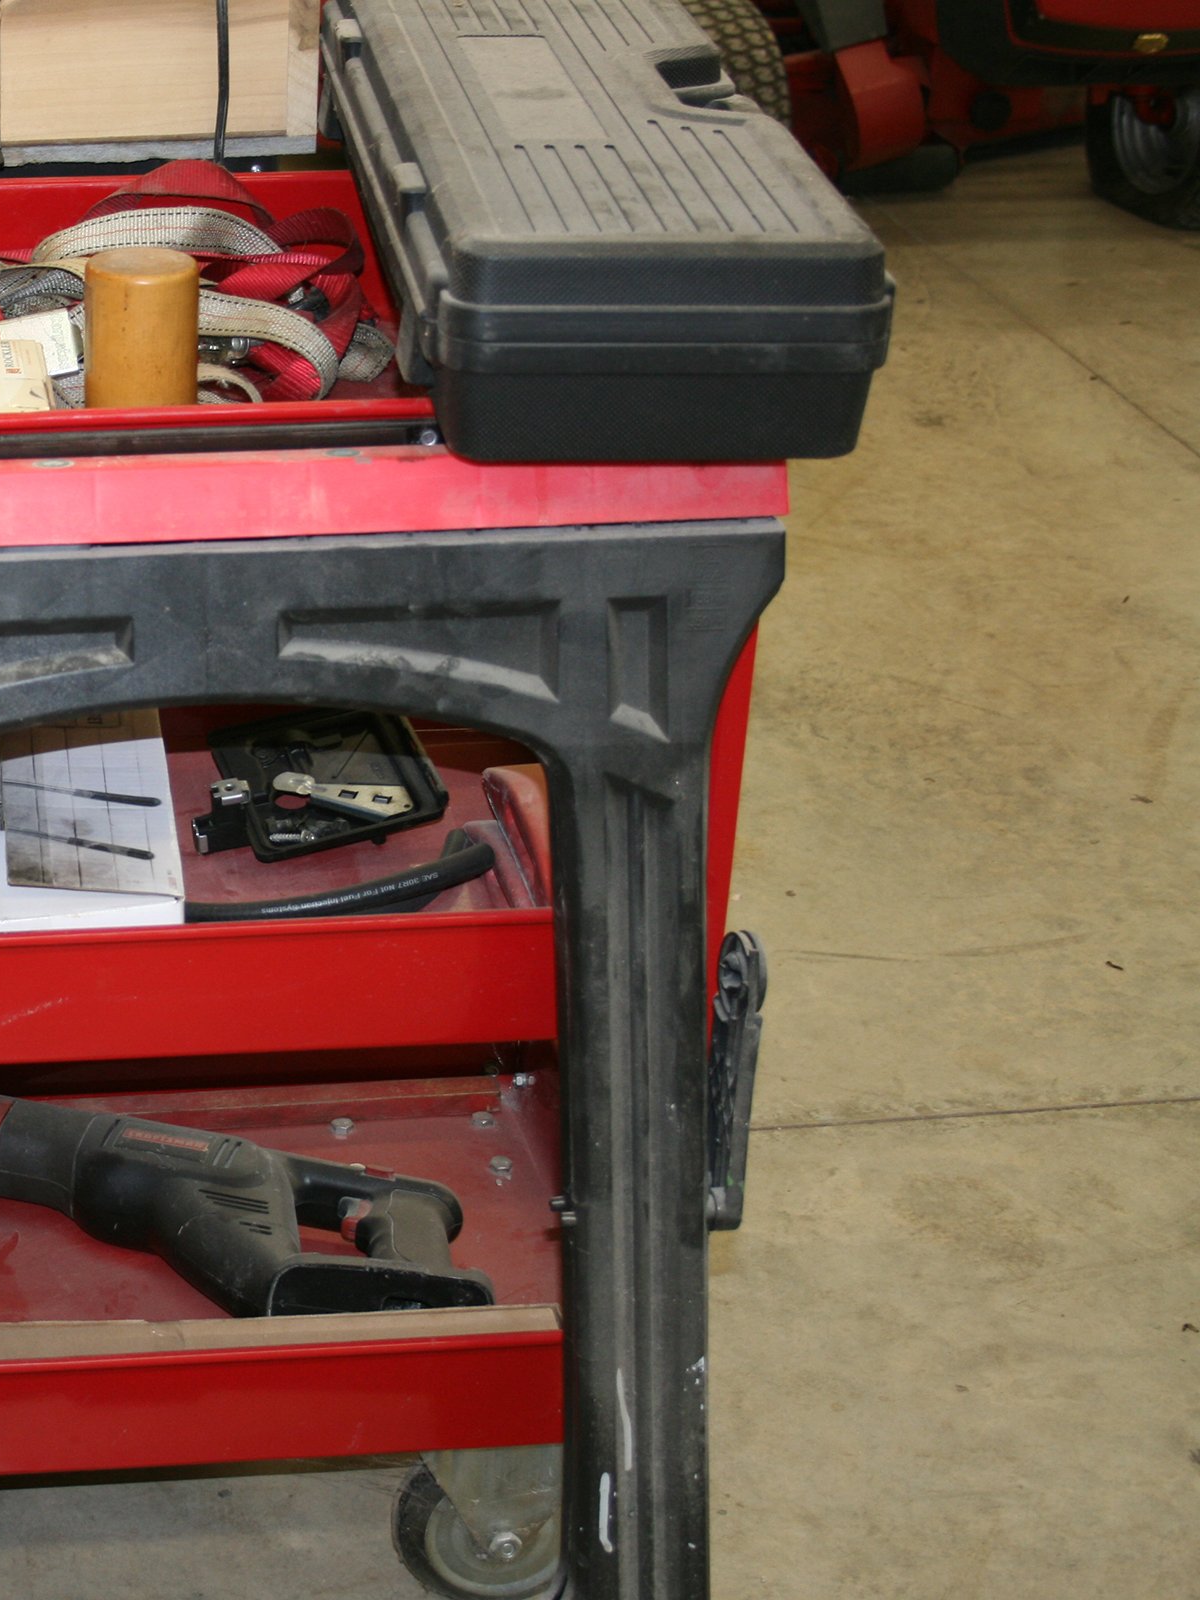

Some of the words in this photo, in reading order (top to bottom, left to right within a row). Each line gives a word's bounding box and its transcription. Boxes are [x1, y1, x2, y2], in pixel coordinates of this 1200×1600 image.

[421, 871, 439, 883] SAE
[397, 877, 420, 889] 30R7
[363, 888, 379, 897] For
[380, 884, 396, 894] Not
[340, 891, 361, 902] Fuel
[260, 903, 298, 914] Systems
[300, 896, 339, 910] Injection
